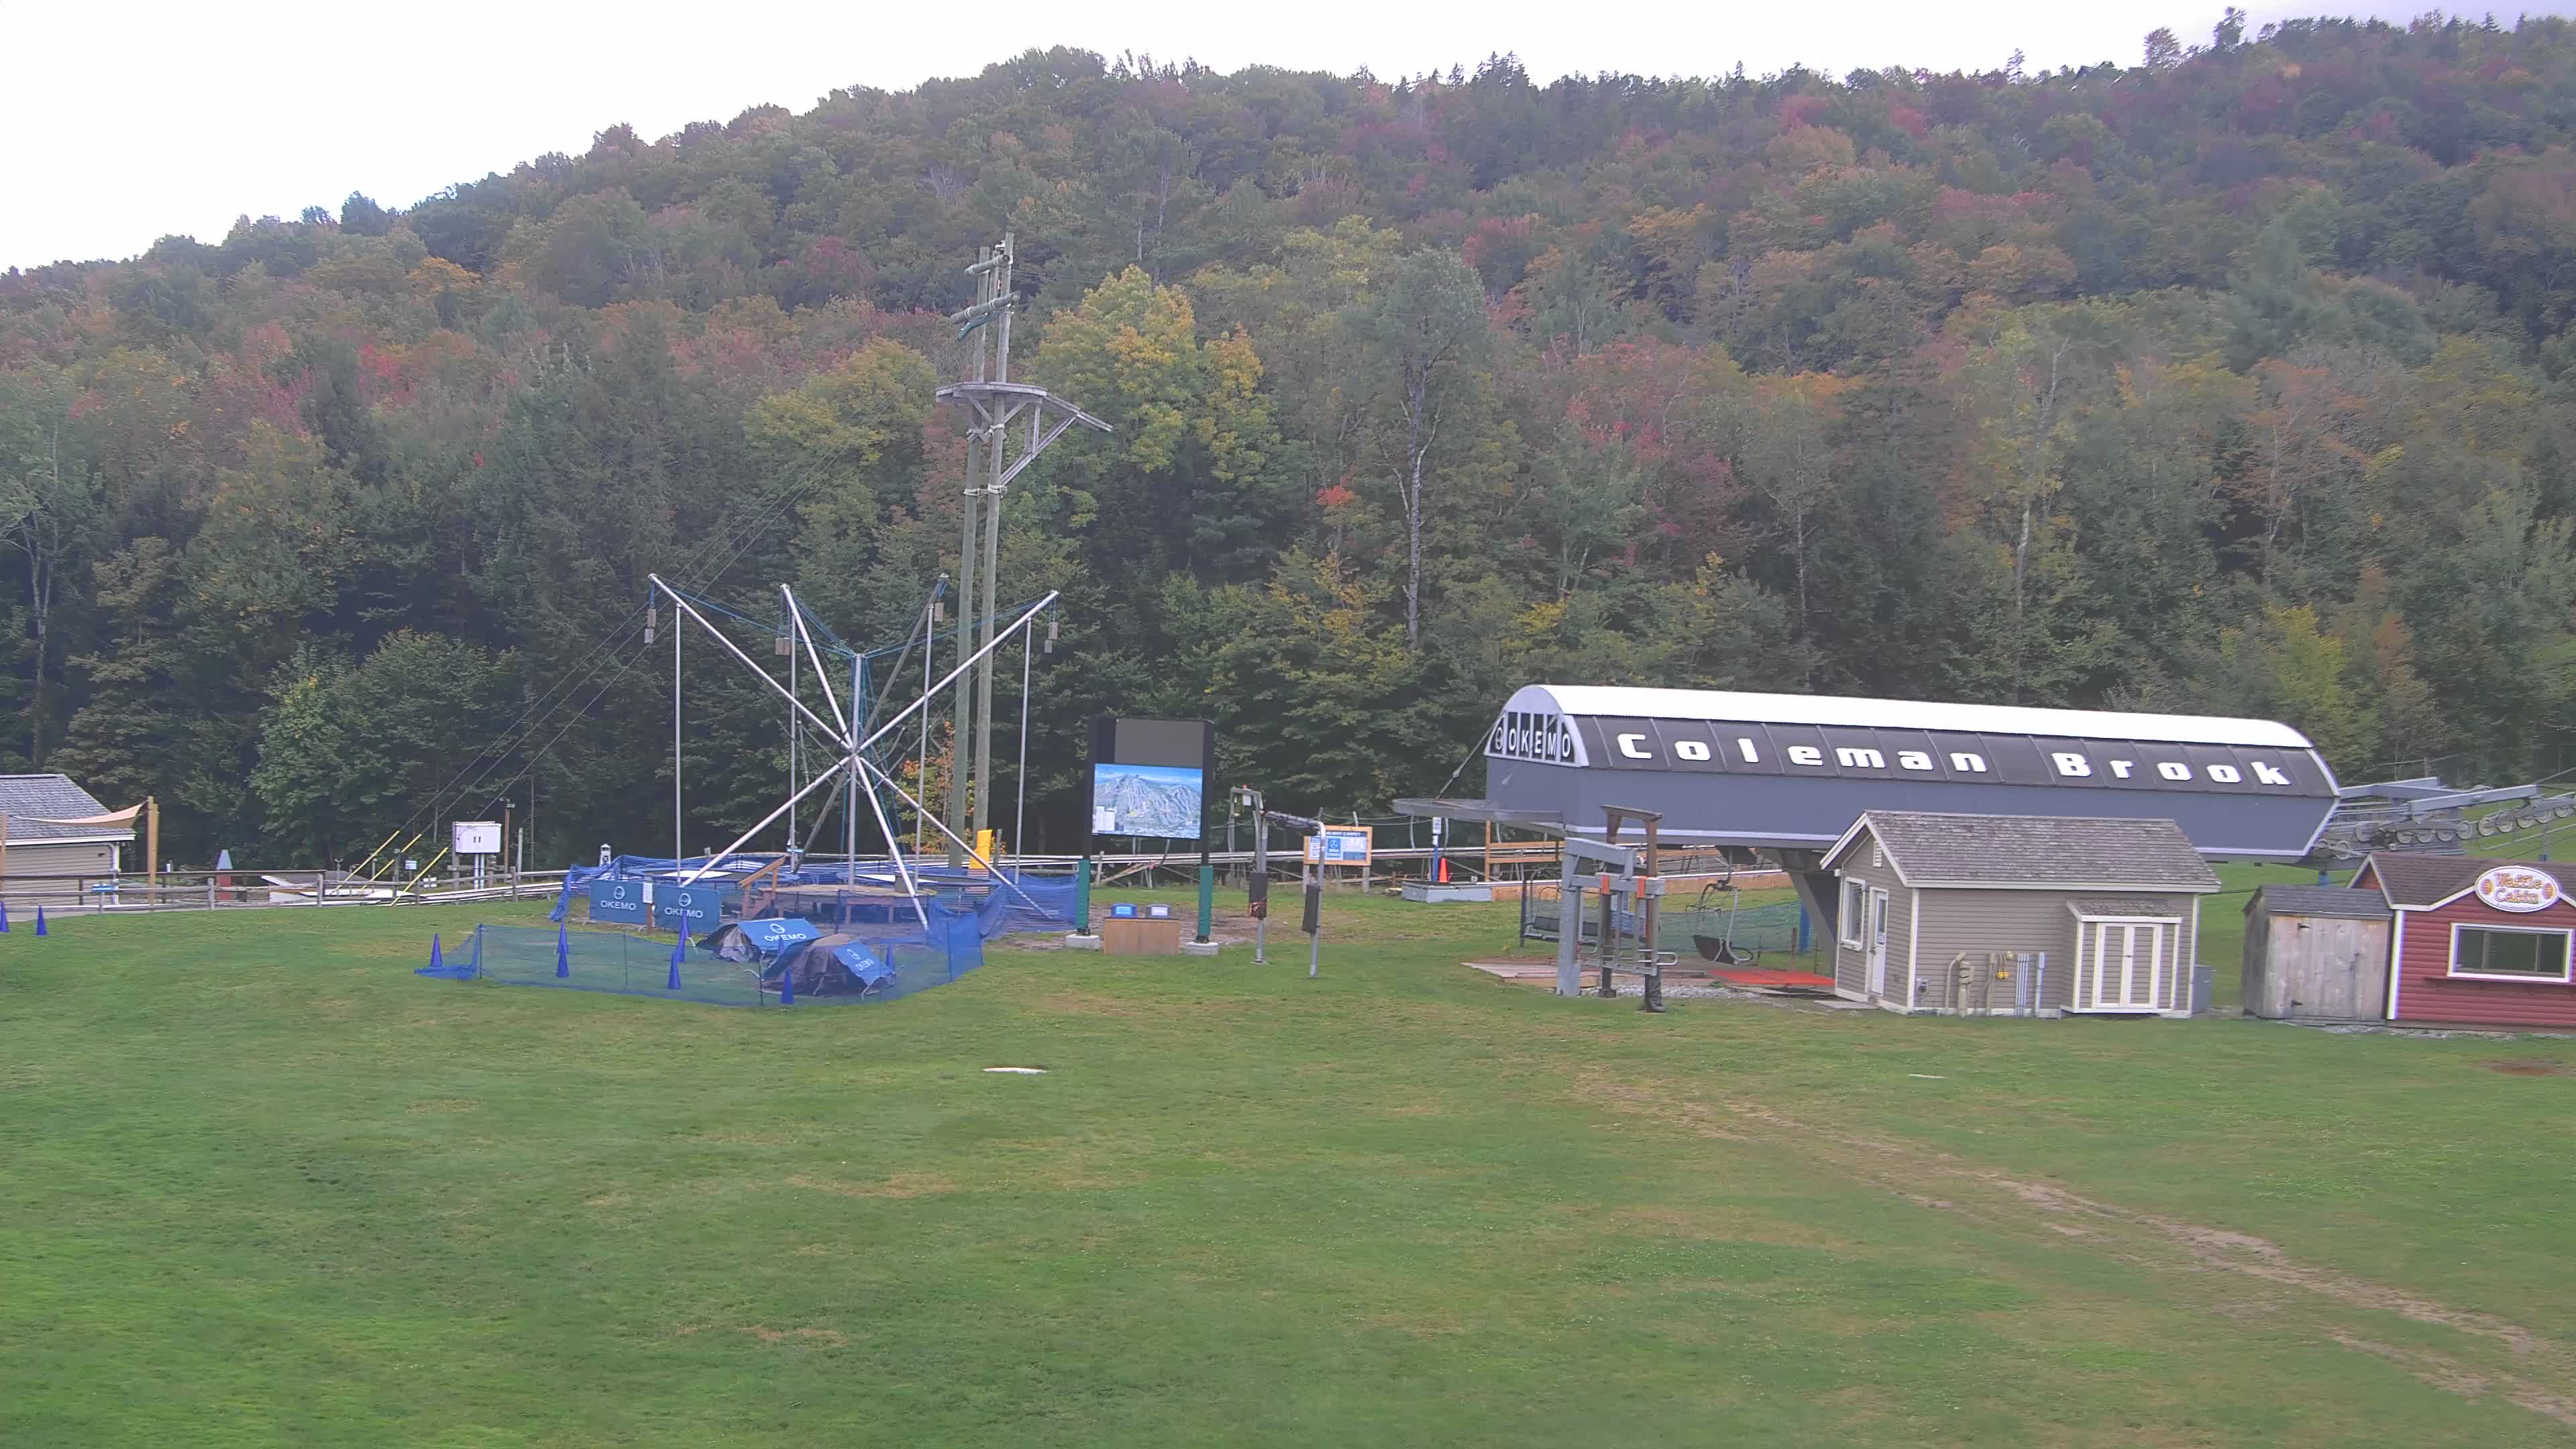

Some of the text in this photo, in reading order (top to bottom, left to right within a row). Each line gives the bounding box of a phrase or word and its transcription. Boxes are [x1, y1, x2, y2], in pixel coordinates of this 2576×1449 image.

[1509, 727, 1571, 758] OKEMO
[1617, 733, 2292, 786] Coleman Brook
[2493, 873, 2543, 890] Waffle
[2495, 888, 2539, 904] Cabin
[600, 900, 637, 911] OKEMO
